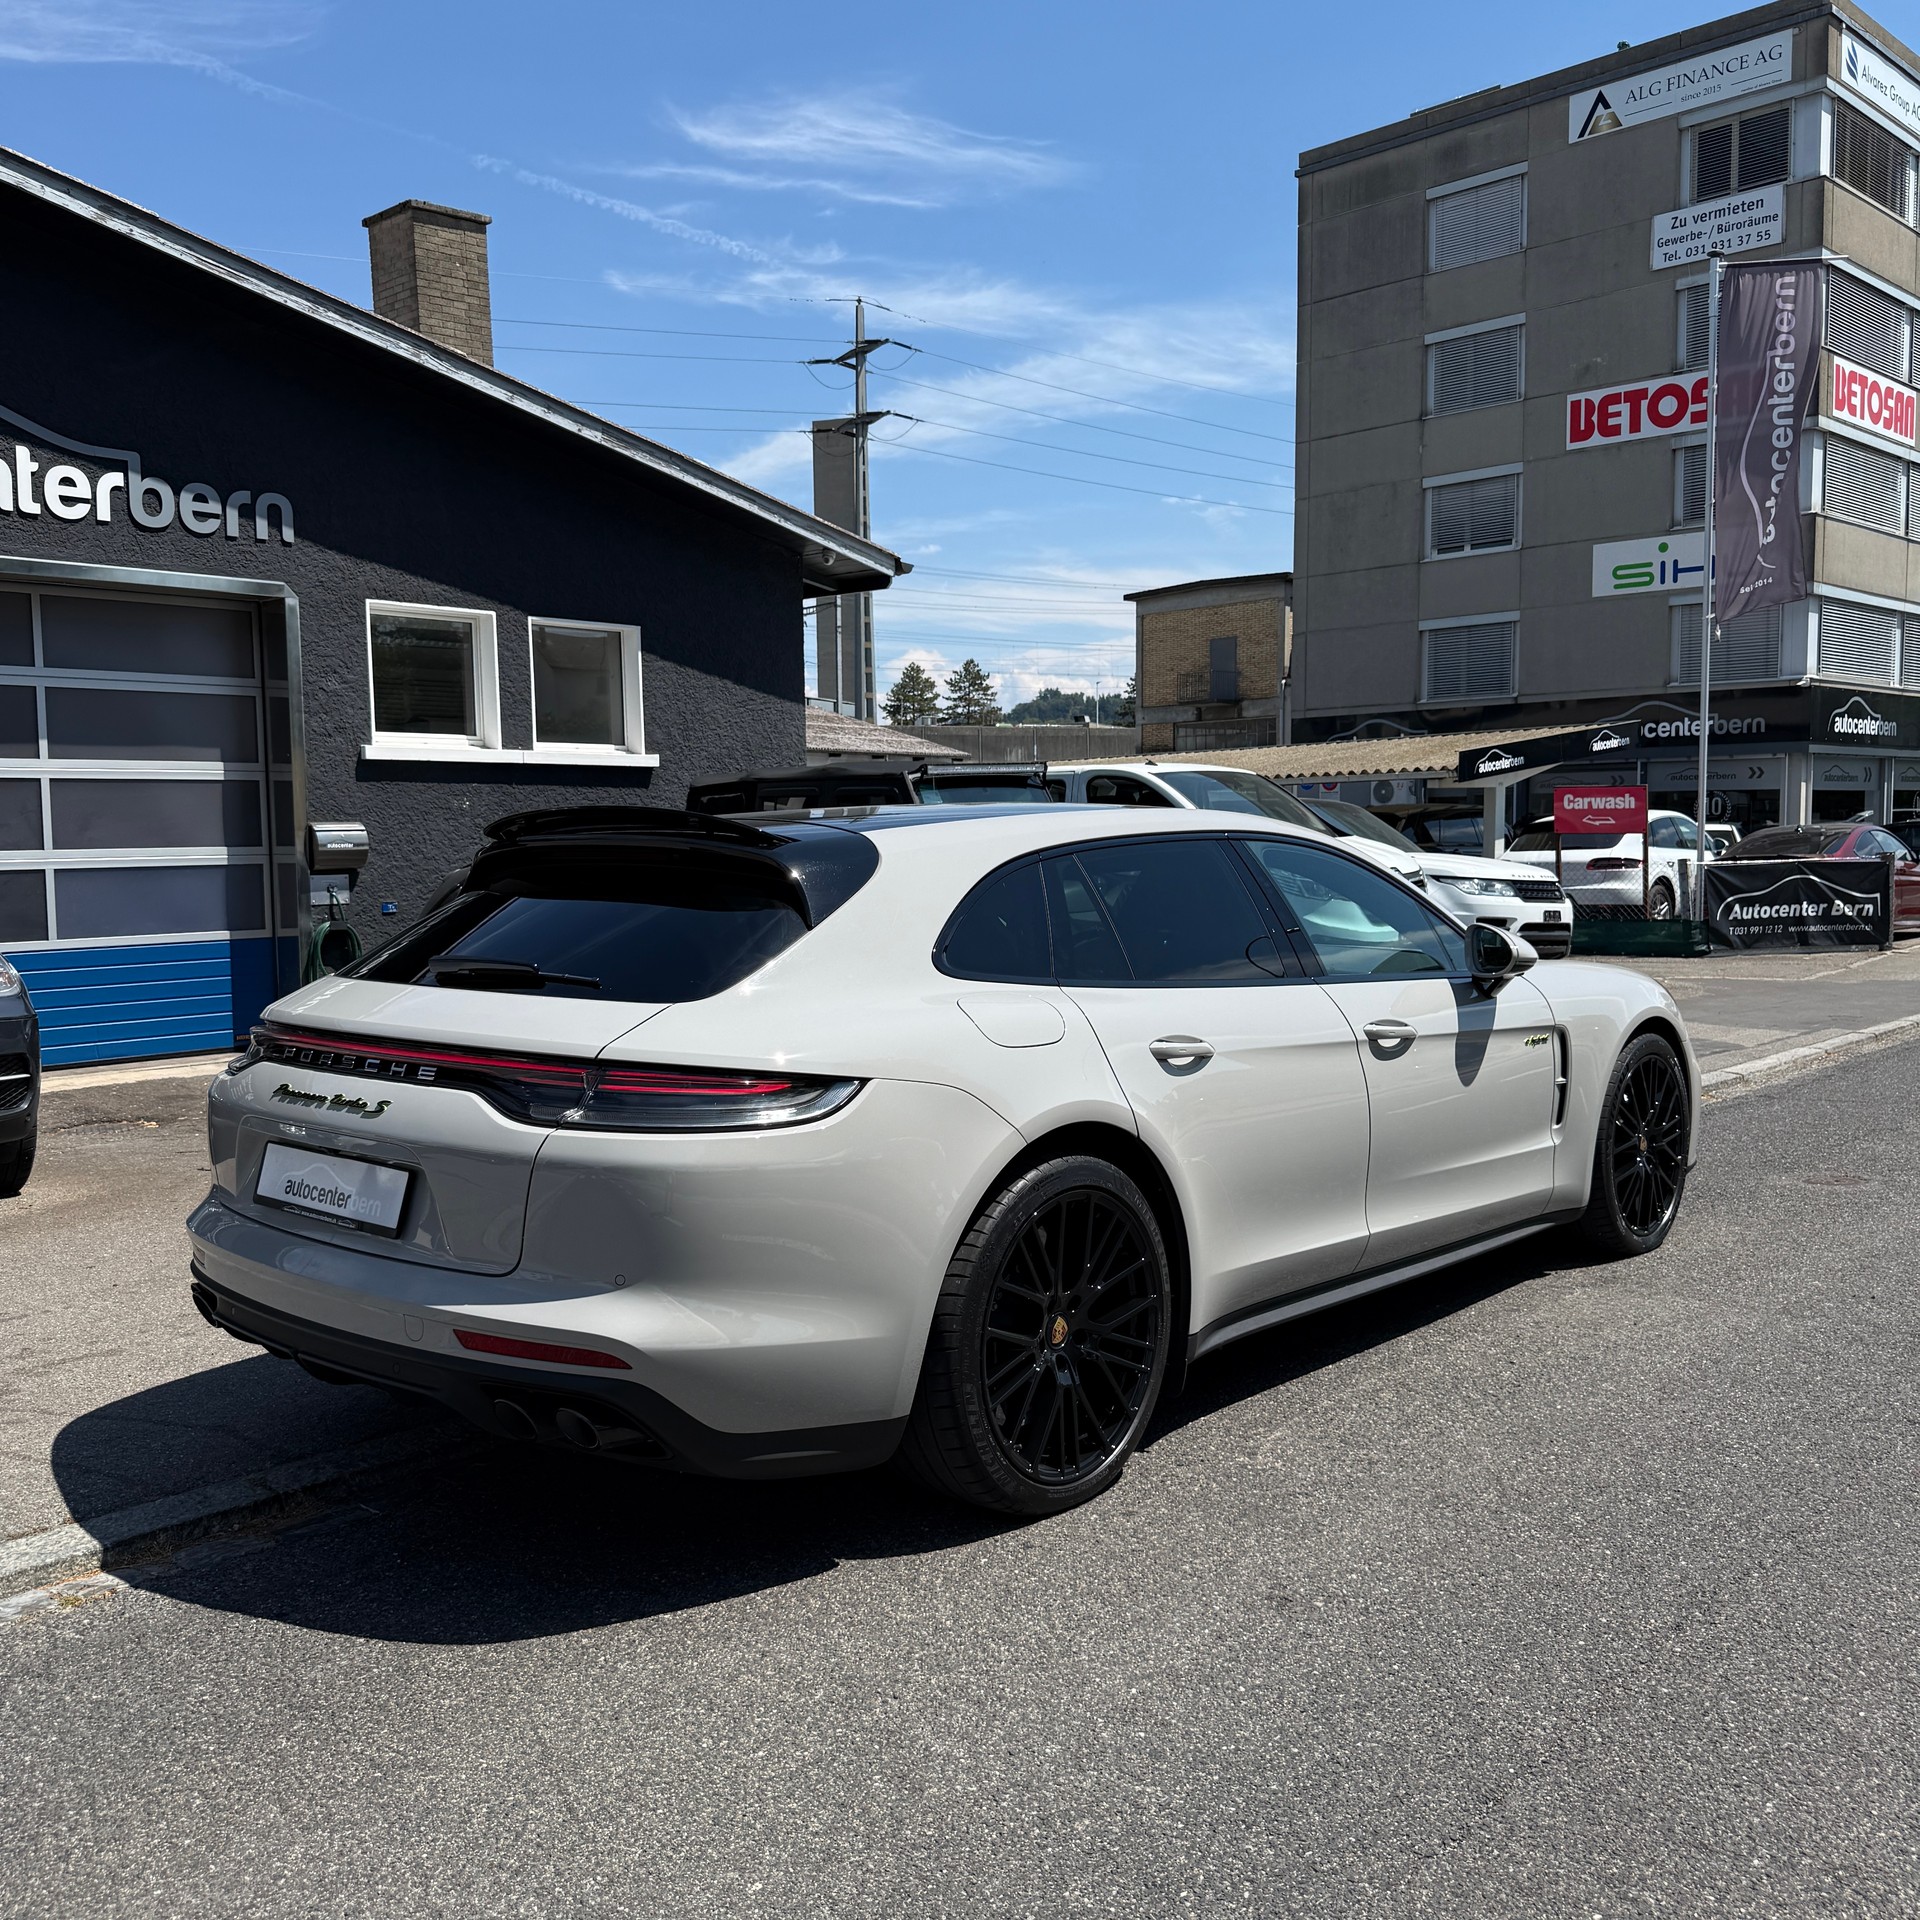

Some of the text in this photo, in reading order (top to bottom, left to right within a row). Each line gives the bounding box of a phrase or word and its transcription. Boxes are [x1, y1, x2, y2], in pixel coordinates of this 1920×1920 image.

[1624, 80, 1662, 104] ALG
[1666, 54, 1750, 93] FINANCE
[1754, 44, 1783, 66] AG
[1680, 83, 1722, 103] since 2015
[1861, 64, 1888, 97] Alvarez
[1889, 85, 1910, 117] Group
[1670, 198, 1765, 230] Zu vermieten
[1716, 212, 1779, 235] Büroräume
[1662, 252, 1682, 263] Tel.
[1685, 244, 1706, 258] 031
[1737, 233, 1752, 247] 37
[1756, 229, 1771, 243] 55
[1569, 377, 1717, 444] BETOS
[1833, 363, 1915, 441] BETOSAN
[1641, 716, 1766, 739] centerbern
[1834, 713, 1897, 737] autocenterbern
[1478, 755, 1525, 774] autocenterbern
[1563, 792, 1636, 810] Carwash
[1728, 899, 1874, 921] Autocenter Bern
[1749, 925, 1763, 934] 991
[1764, 925, 1773, 934] 12
[1774, 924, 1783, 933] 12
[283, 1047, 438, 1081] PORSCHE
[364, 1099, 394, 1114] S
[284, 1178, 382, 1217] autocenterbern
